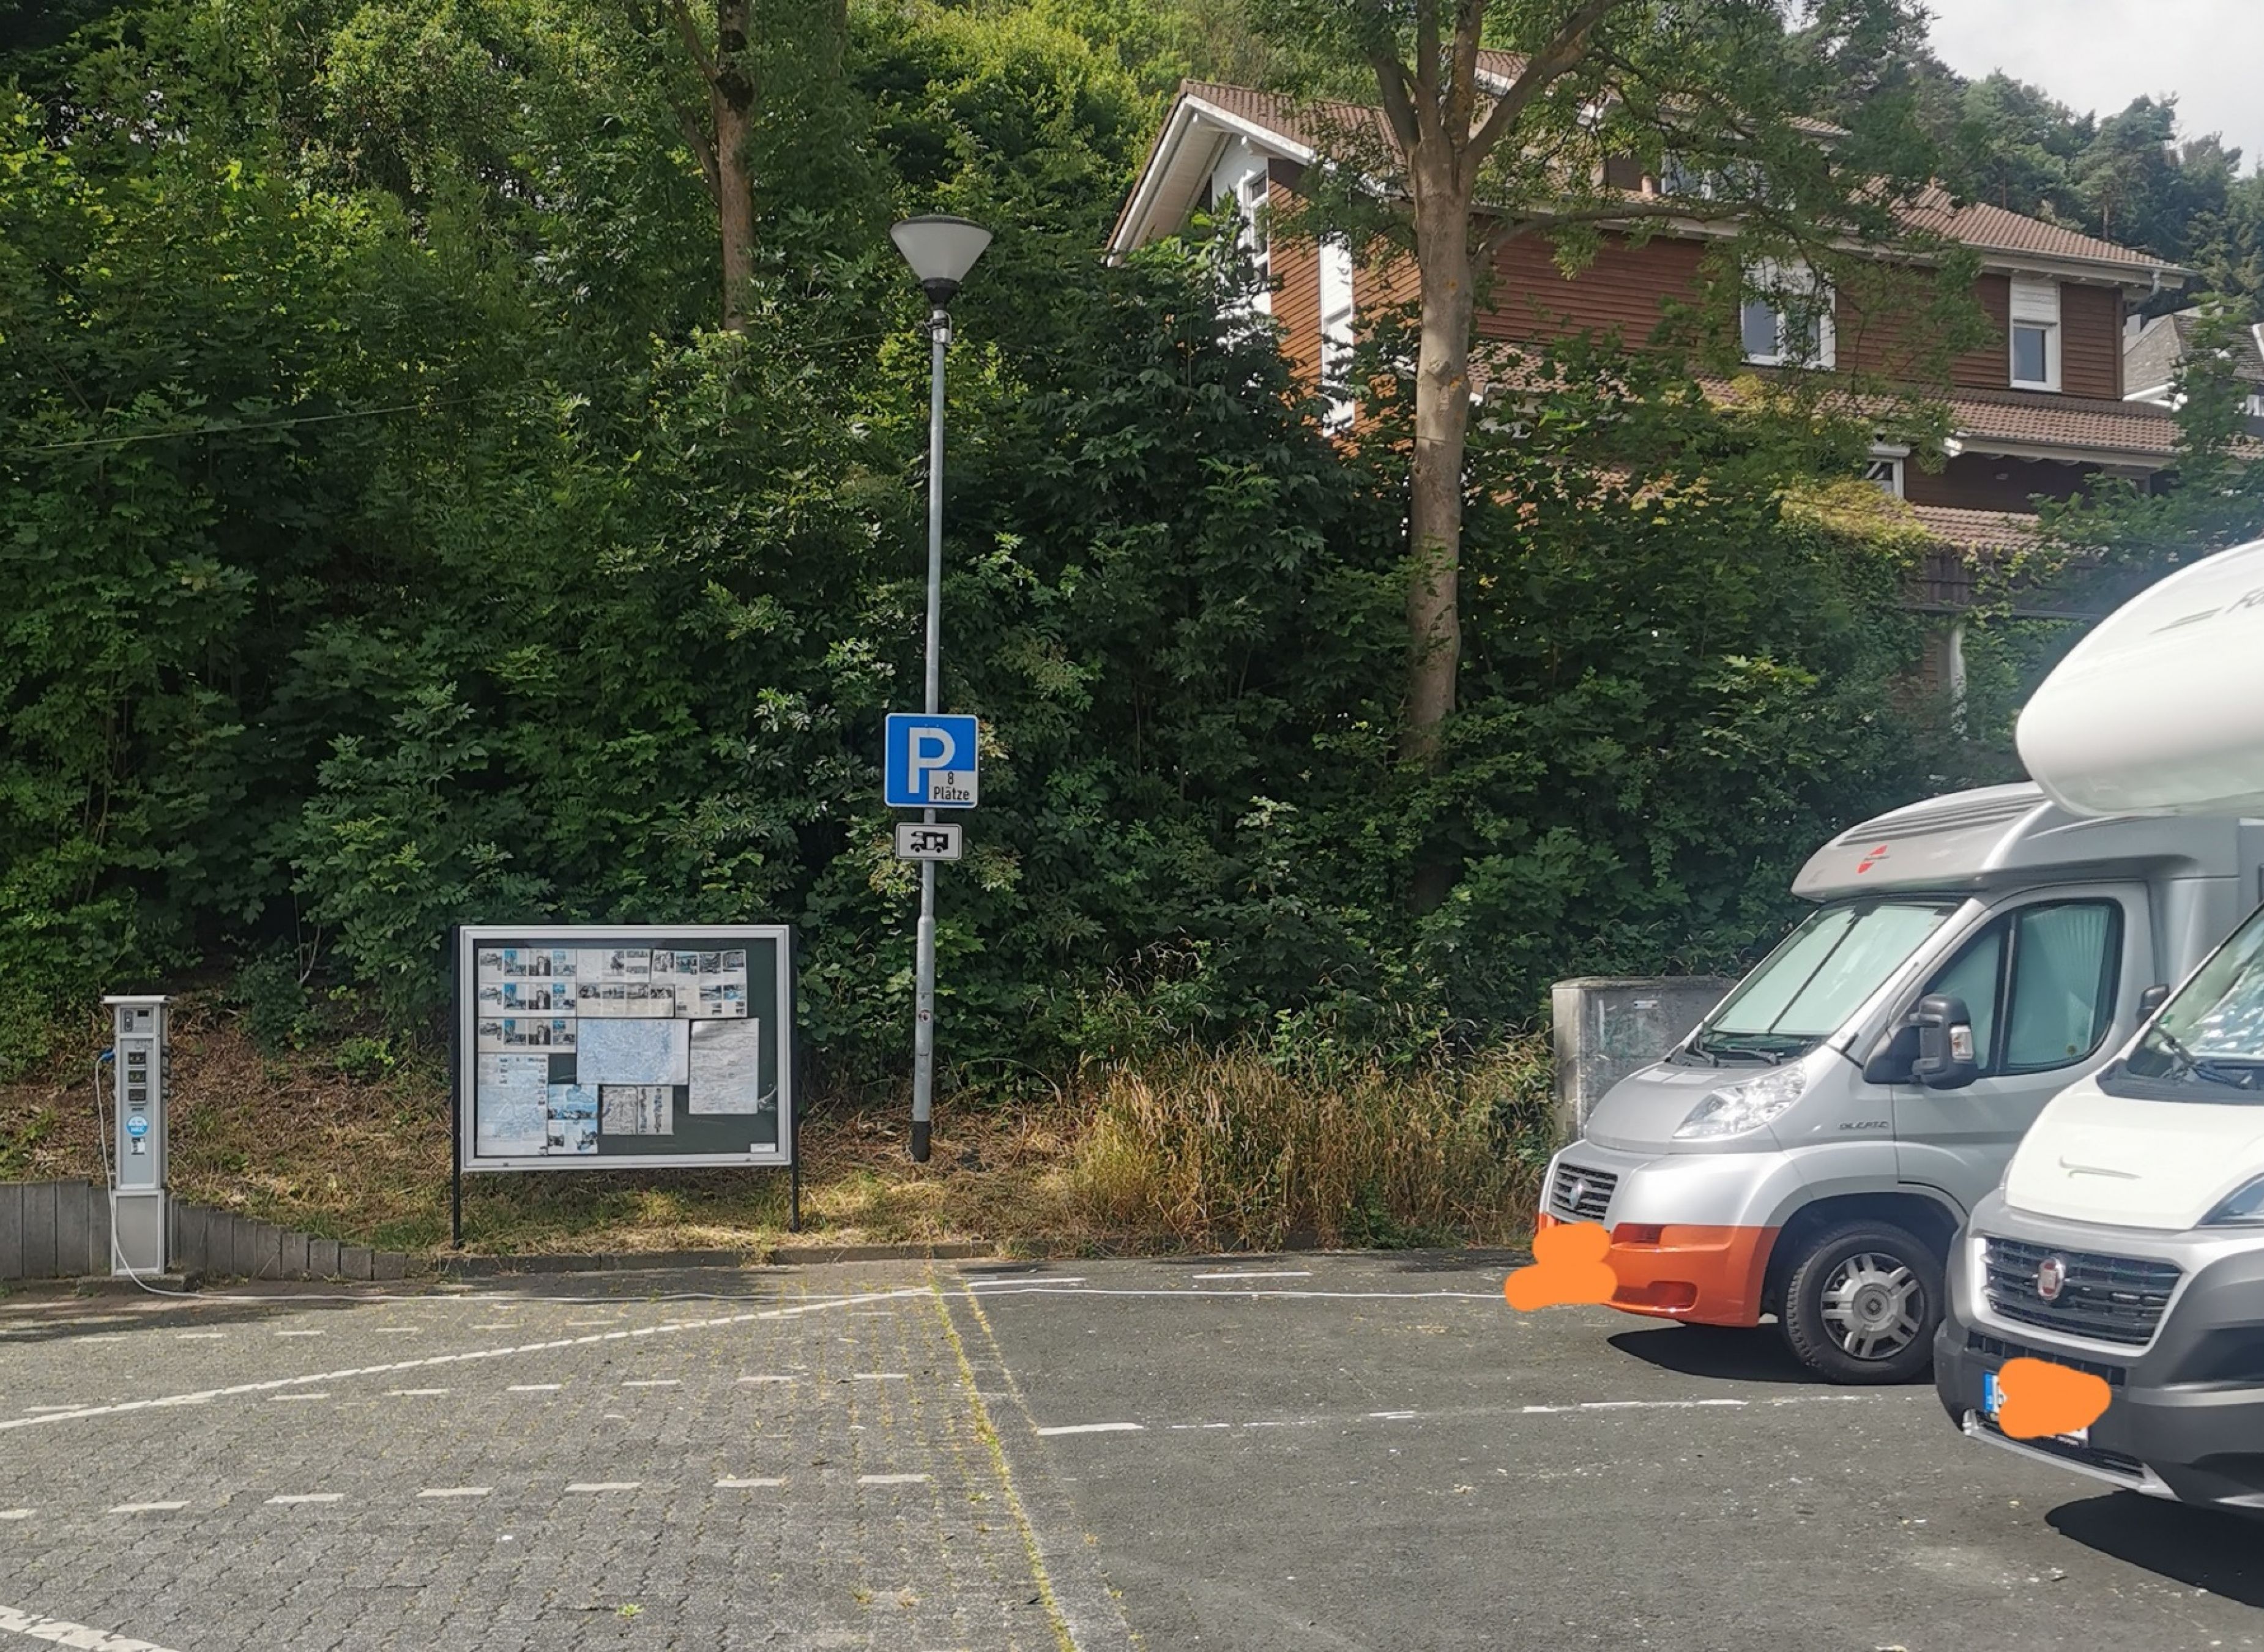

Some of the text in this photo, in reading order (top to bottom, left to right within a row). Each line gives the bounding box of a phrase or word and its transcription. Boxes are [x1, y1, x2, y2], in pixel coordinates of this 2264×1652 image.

[909, 727, 955, 794] P
[948, 771, 954, 784] 8
[934, 786, 970, 800] Plätze
